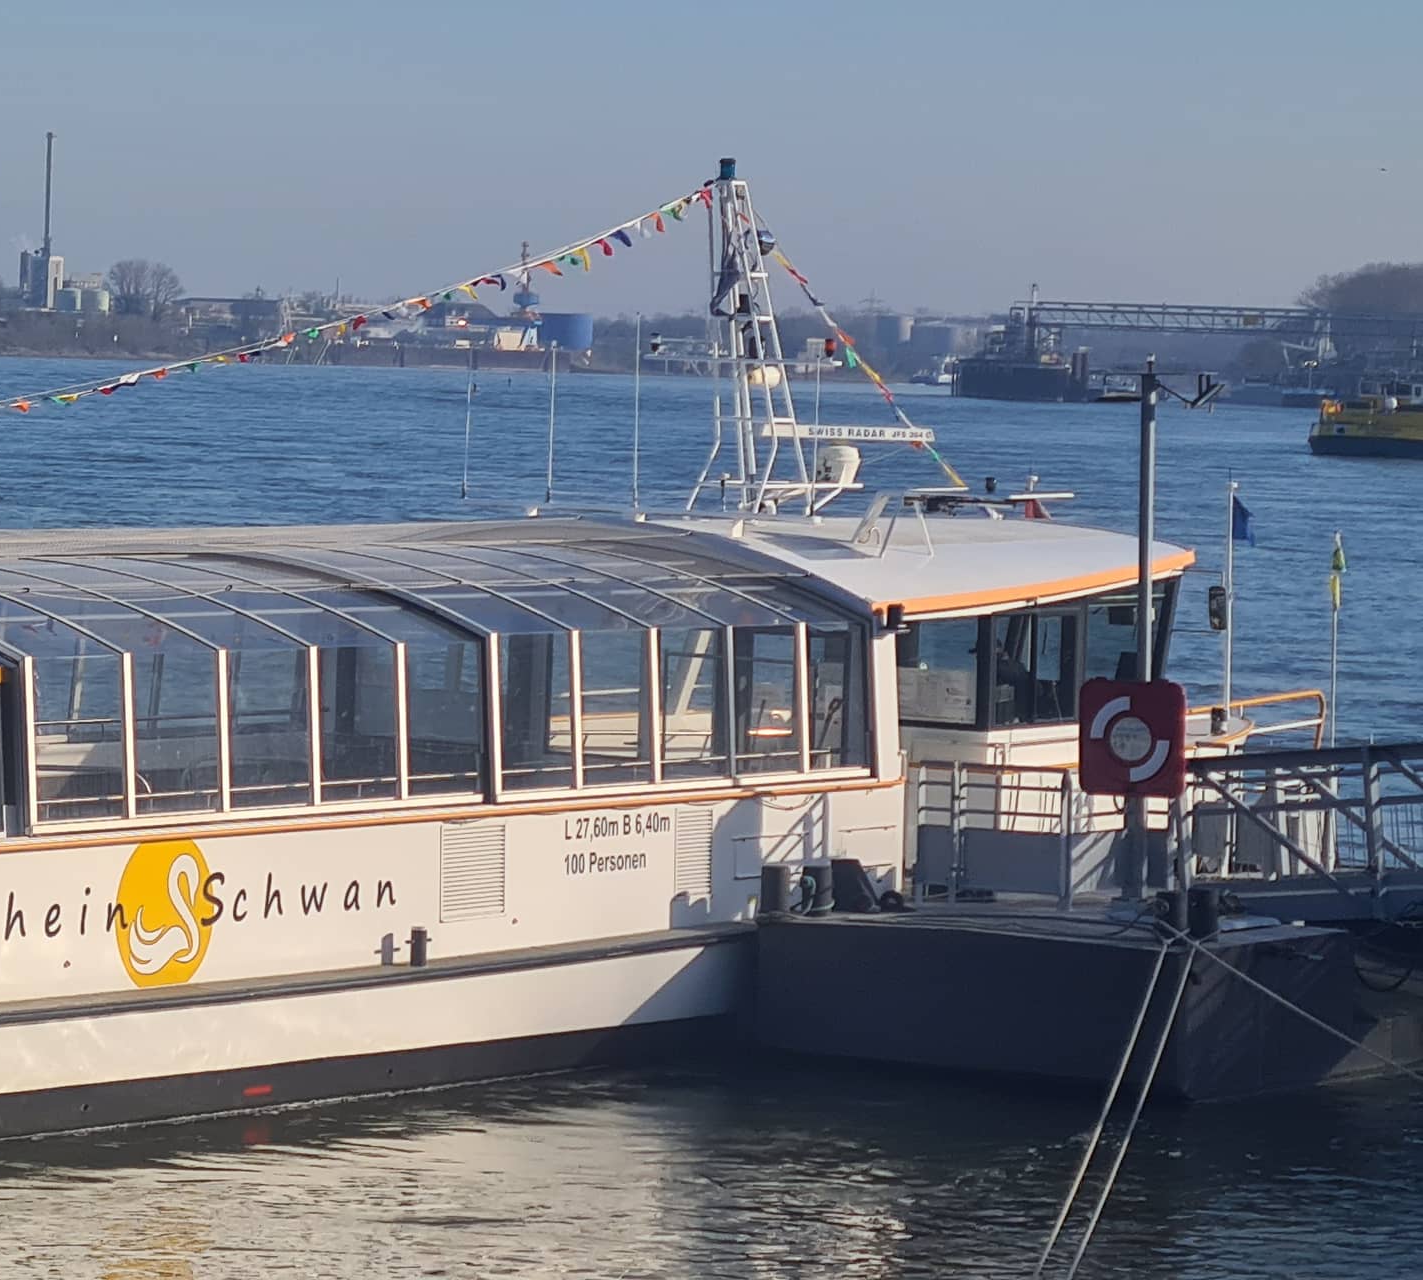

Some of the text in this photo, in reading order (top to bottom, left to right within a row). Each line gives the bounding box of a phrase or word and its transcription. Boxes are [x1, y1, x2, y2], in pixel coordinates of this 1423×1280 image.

[808, 427, 843, 437] SWISS
[848, 428, 886, 438] RADAR
[564, 812, 671, 842] L 27,60m B 6,40m
[564, 851, 647, 875] 100 Personen
[200, 871, 397, 926] Schwan
